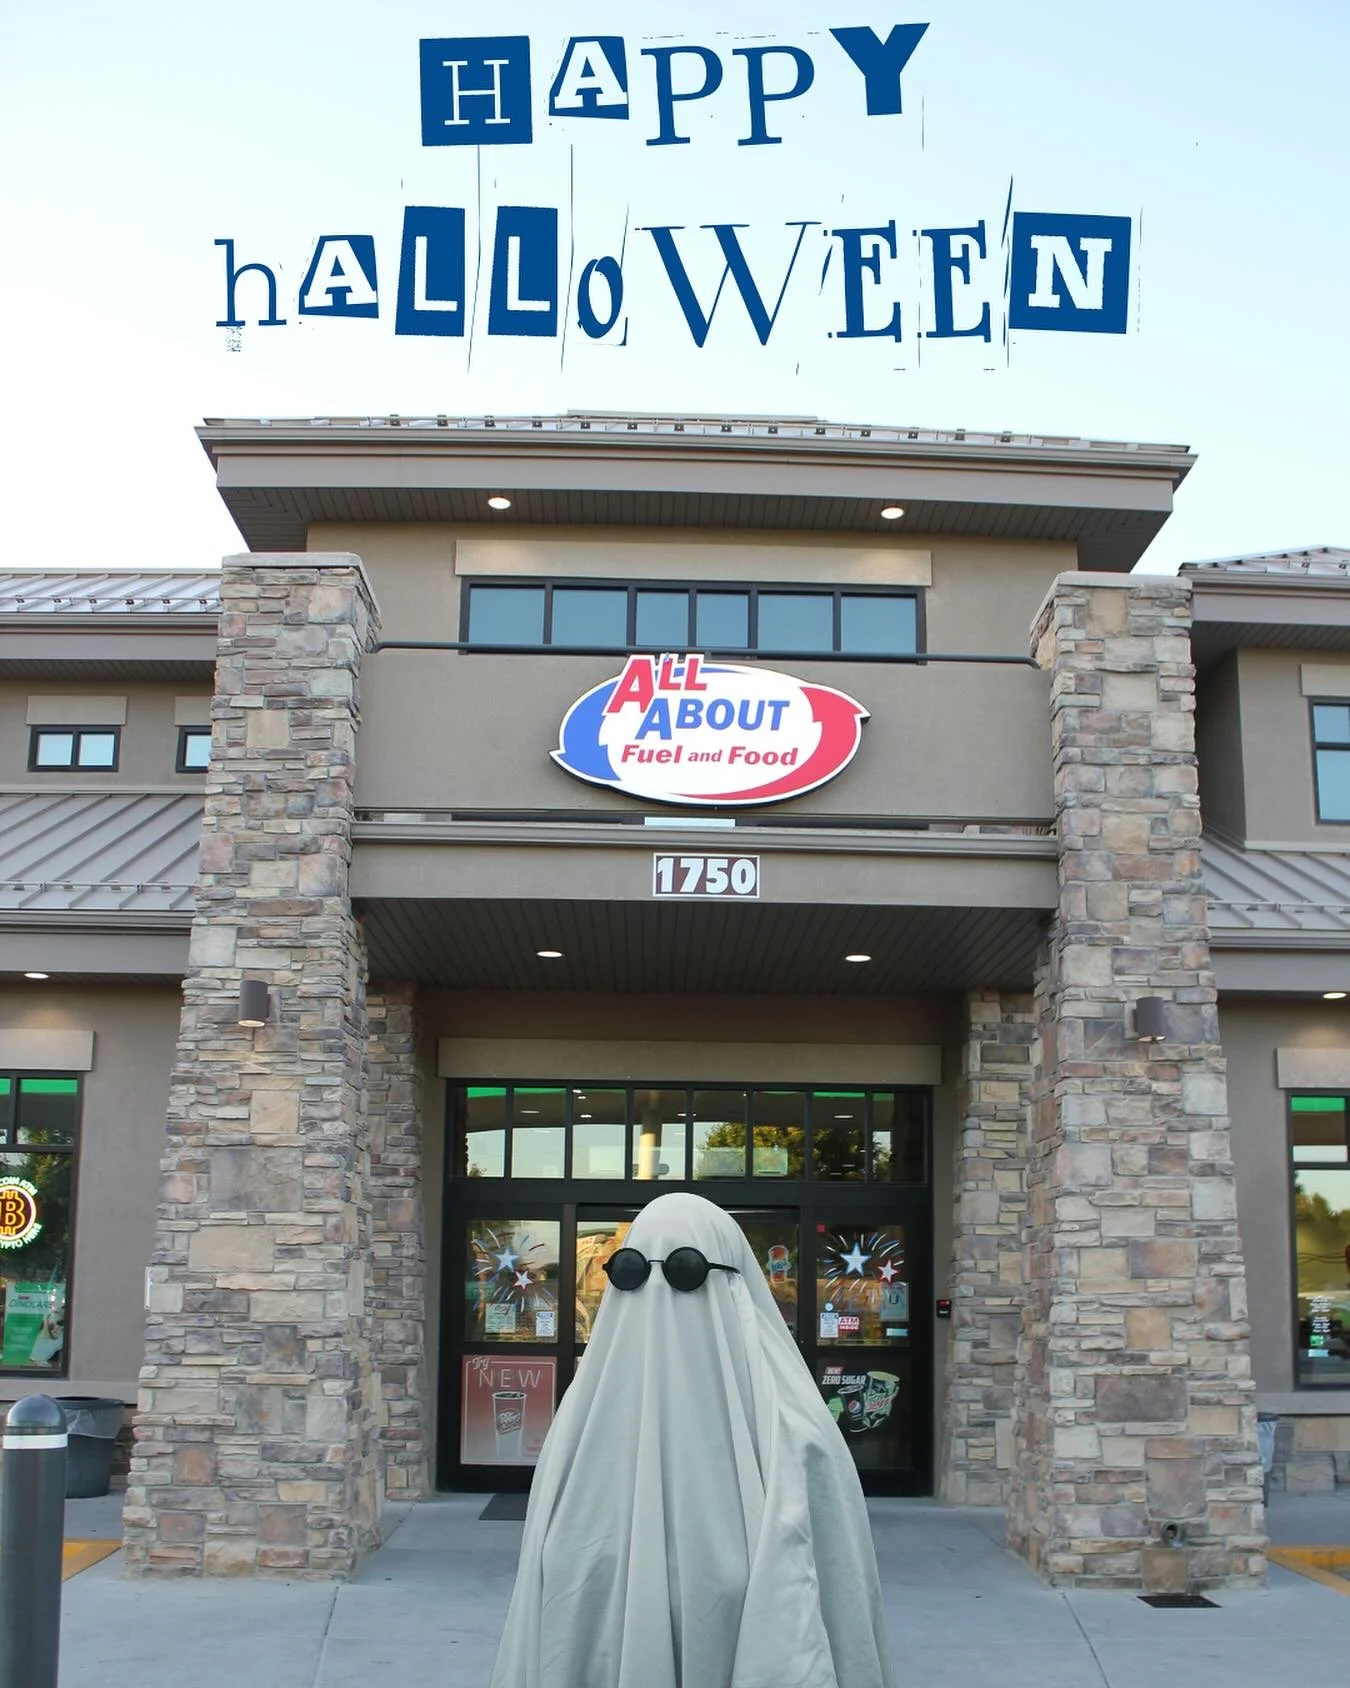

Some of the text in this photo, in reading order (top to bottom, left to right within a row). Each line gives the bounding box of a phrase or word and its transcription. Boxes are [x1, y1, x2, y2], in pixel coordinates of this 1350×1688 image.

[606, 657, 708, 714] ALL
[634, 697, 791, 741] ABOUT
[620, 743, 799, 766] Fuel and Food
[656, 857, 757, 895] 1750
[478, 1368, 541, 1388] NEW
[822, 1375, 866, 1384] ZERO SUGAR
